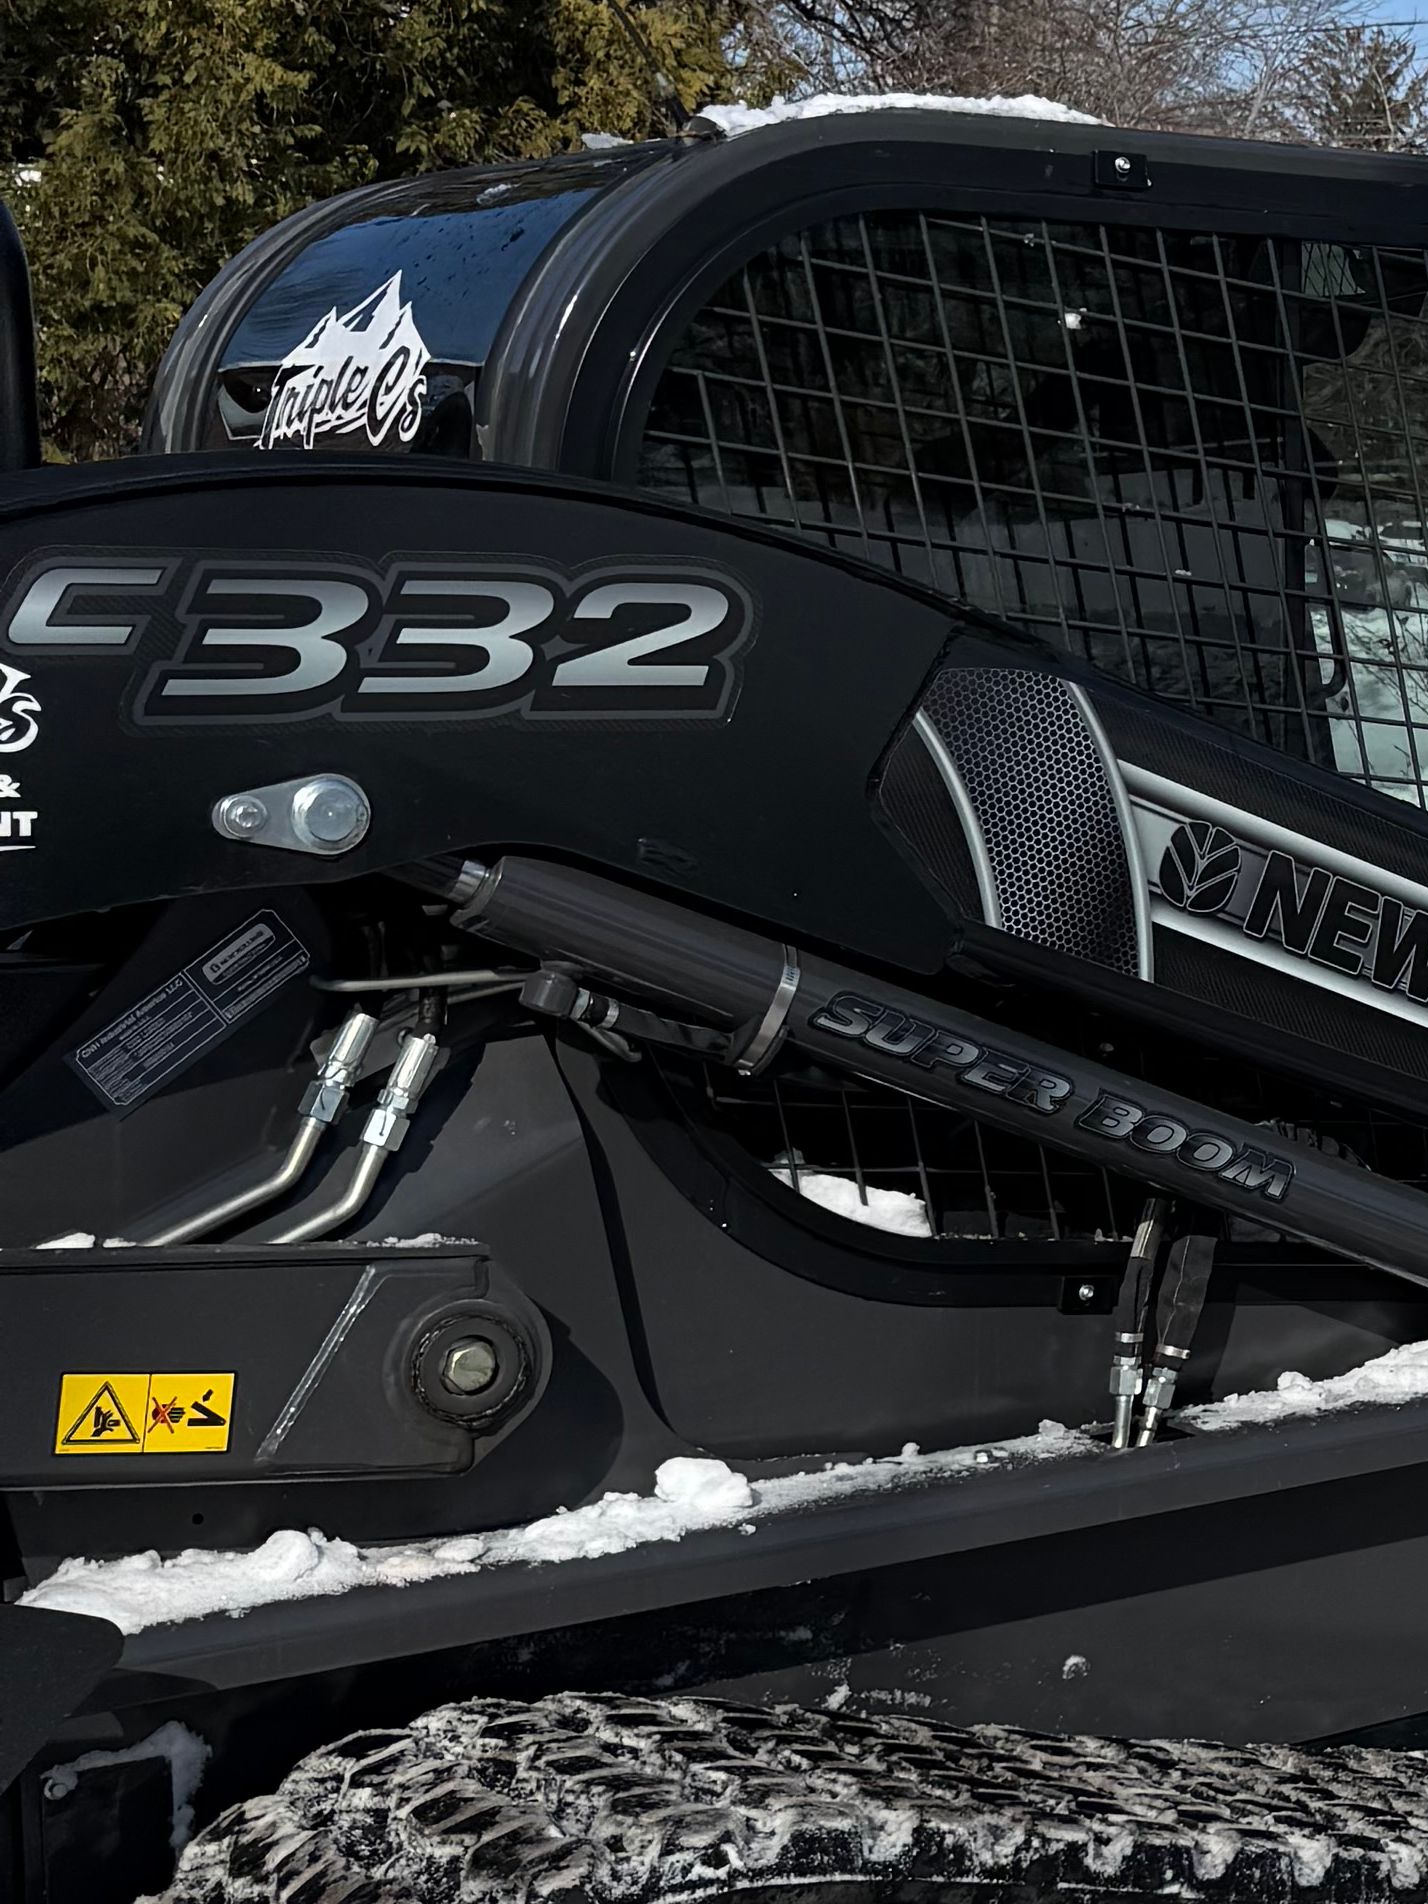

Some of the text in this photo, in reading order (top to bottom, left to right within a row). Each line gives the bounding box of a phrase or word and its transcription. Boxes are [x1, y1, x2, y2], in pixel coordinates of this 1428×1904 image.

[260, 354, 371, 449] Triple
[8, 568, 730, 696] C332
[809, 991, 1297, 1199] SUPER BOOM
